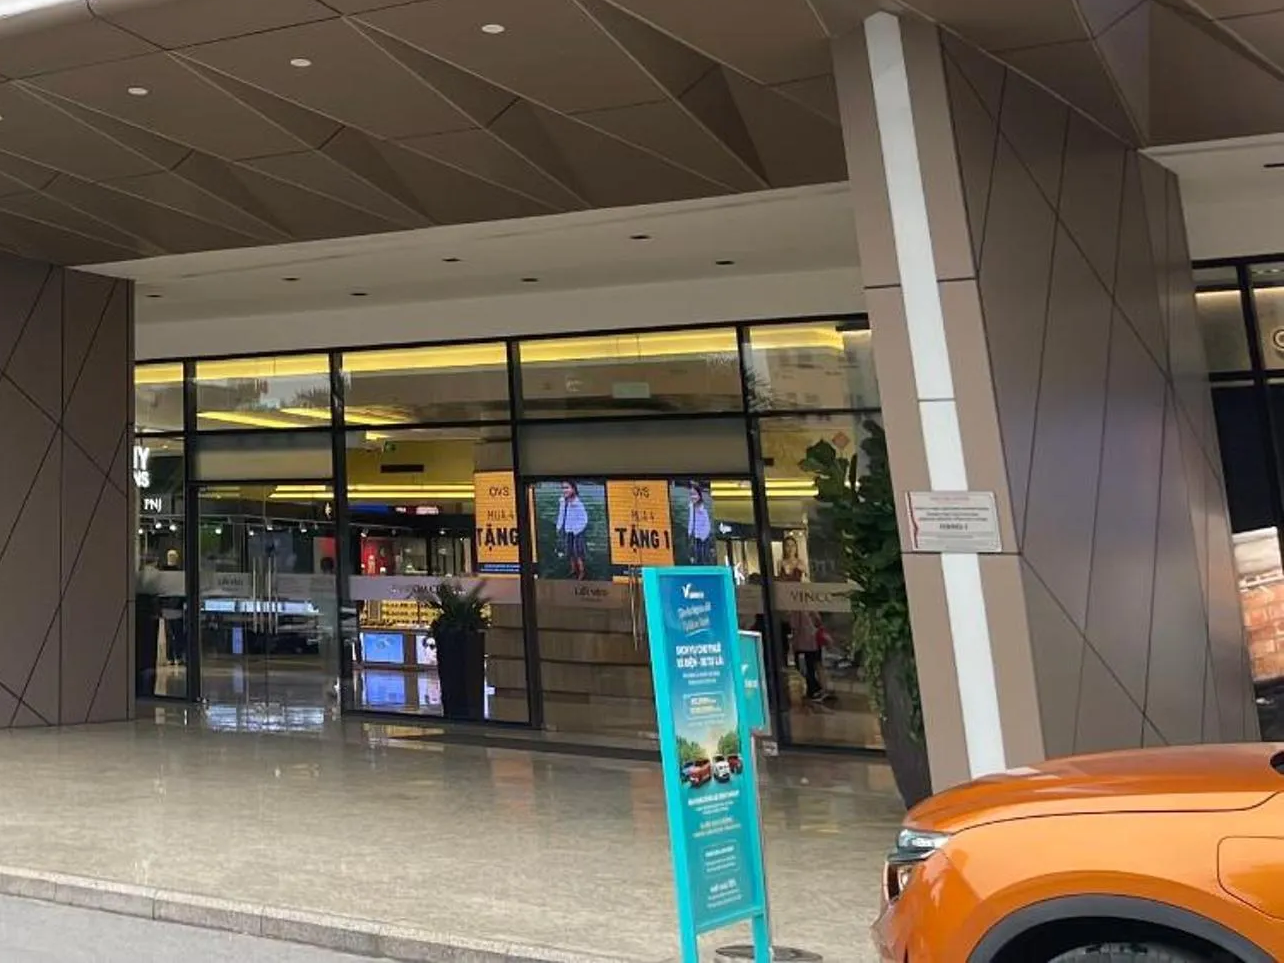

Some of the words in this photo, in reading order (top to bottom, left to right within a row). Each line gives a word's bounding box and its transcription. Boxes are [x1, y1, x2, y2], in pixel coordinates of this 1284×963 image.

[489, 486, 510, 497] OVS
[143, 497, 162, 513] PNJ
[614, 524, 660, 554] TẶNG
[663, 530, 670, 550] 1
